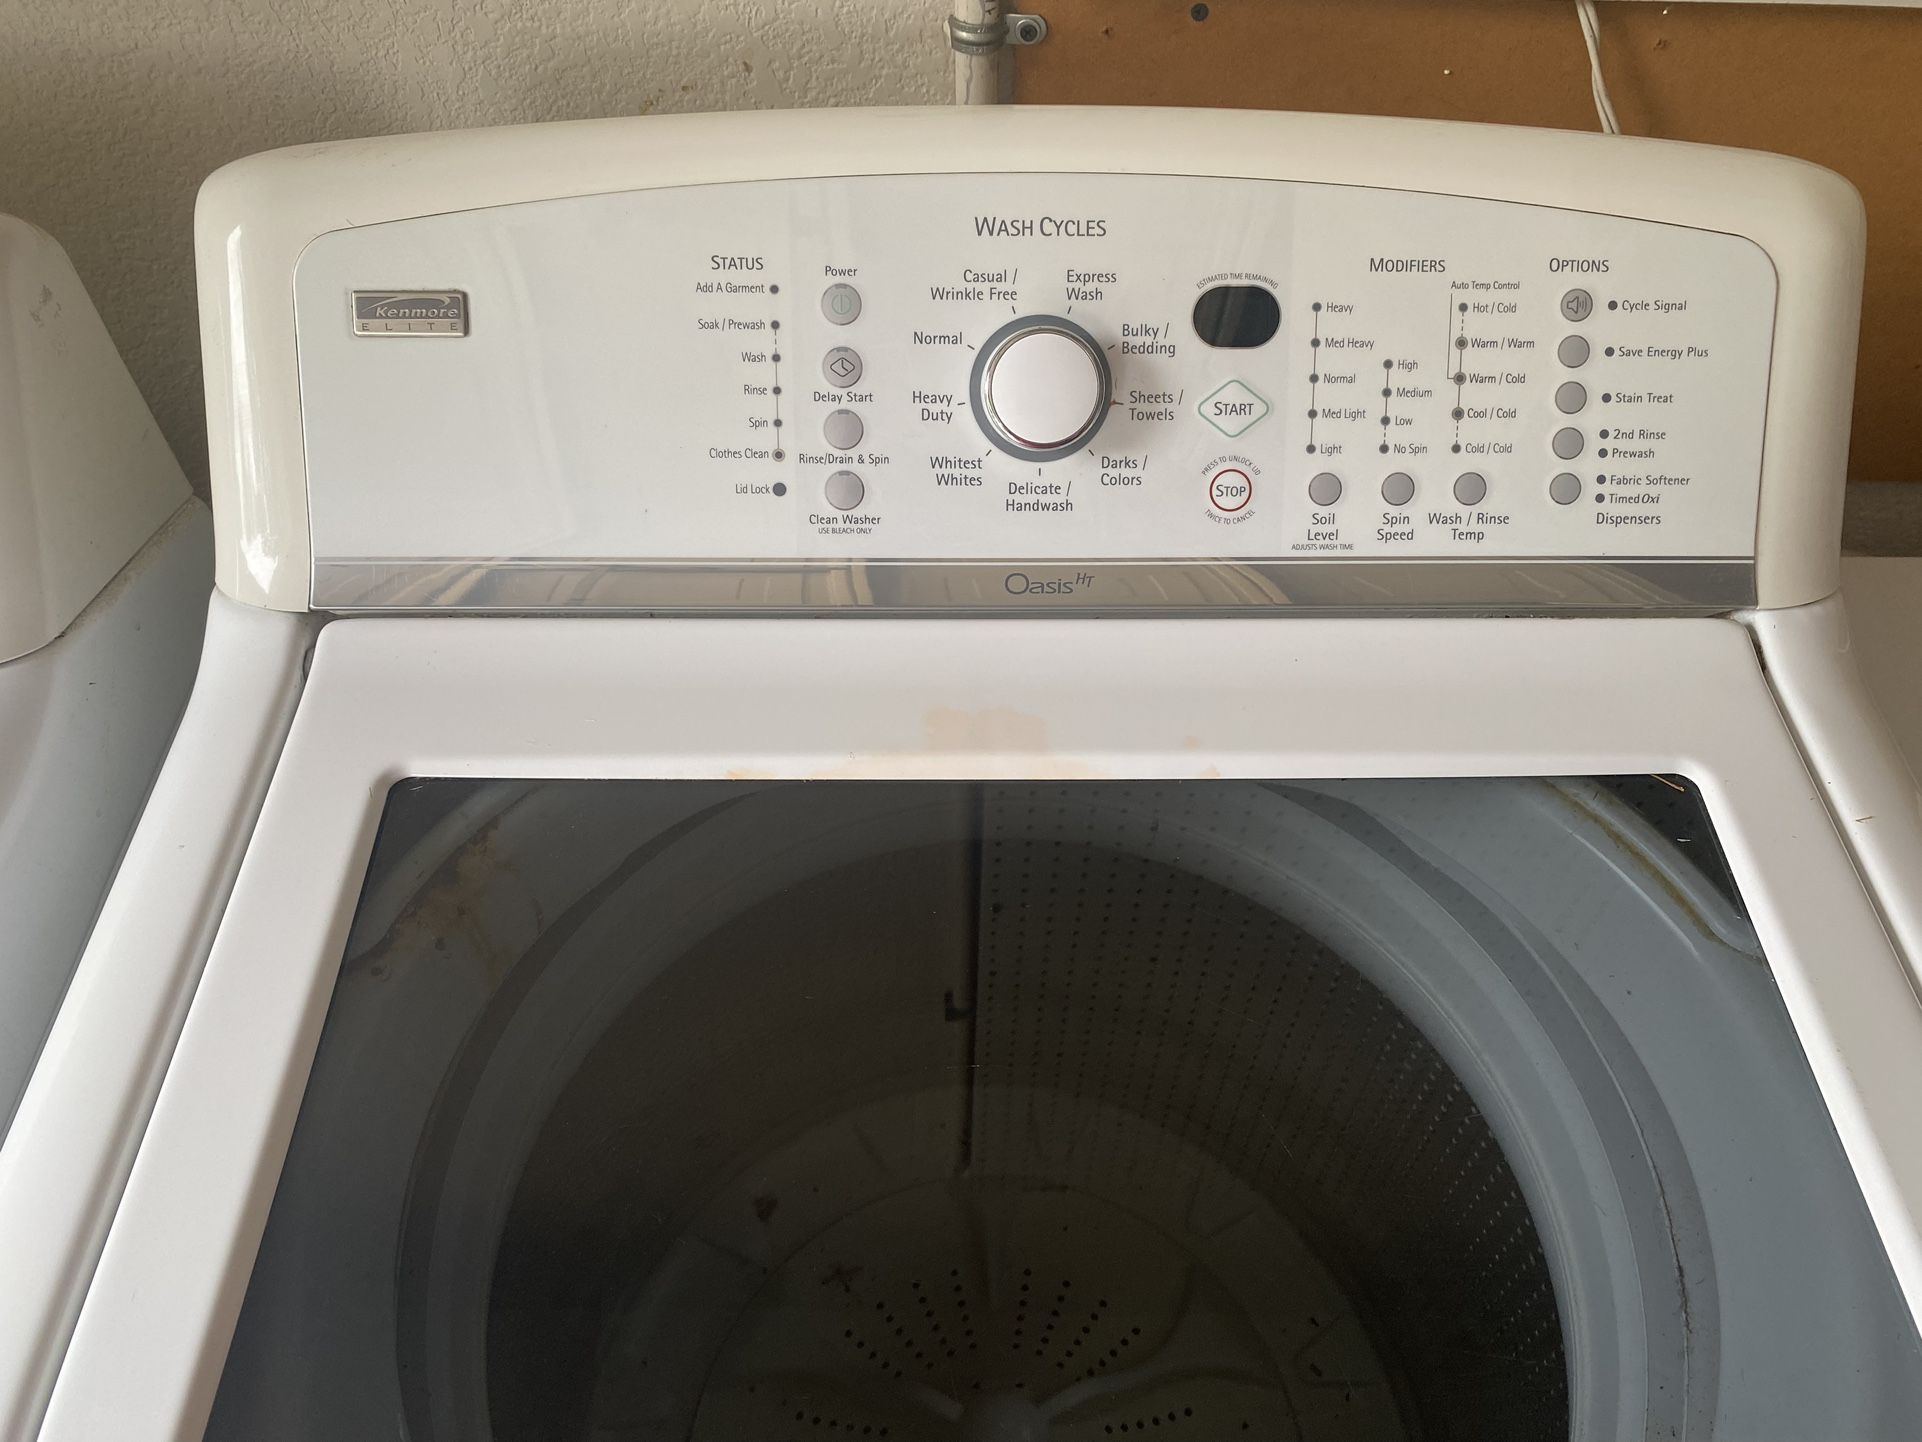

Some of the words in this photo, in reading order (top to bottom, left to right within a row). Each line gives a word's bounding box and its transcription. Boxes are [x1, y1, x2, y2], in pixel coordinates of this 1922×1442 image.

[974, 216, 1033, 236] WASH
[1039, 216, 1107, 237] CYCLES
[711, 255, 763, 270] STATUS
[1369, 258, 1446, 273] MODIFIERS
[1549, 257, 1609, 273] OPTIONS
[825, 266, 858, 277] Power
[963, 269, 1007, 283] Casual
[1066, 269, 1117, 286] Express
[695, 282, 714, 293] Add
[716, 282, 724, 293] A
[725, 282, 765, 294] Garment
[1196, 273, 1229, 290] ESTIMATED
[1244, 273, 1279, 290] REMAINING
[1450, 281, 1469, 290] Auto
[1471, 281, 1491, 291] Temp
[1493, 281, 1520, 290] Control
[930, 287, 984, 301] Wrinkle
[990, 287, 1018, 301] Free
[1066, 287, 1103, 301] Wash
[375, 306, 459, 318] Kenmore
[1326, 302, 1354, 315] Heavy
[1472, 303, 1489, 313] Hot
[1497, 302, 1517, 313] Cold
[1621, 300, 1650, 313] Cycle
[1654, 300, 1687, 313] Signal
[361, 322, 459, 331] ELITE
[697, 318, 720, 330] Soak
[728, 319, 766, 330] Prewash
[913, 331, 963, 345] Normal
[1122, 324, 1159, 339] Bulky
[1121, 342, 1176, 357] Bedding
[1325, 338, 1345, 349] Med
[1347, 338, 1375, 350] Heavy
[1470, 338, 1498, 349] Warm
[1507, 338, 1535, 349] Warm
[741, 352, 767, 363] Wash
[1618, 346, 1643, 357] Save
[1647, 346, 1684, 360] Energy
[1687, 346, 1709, 358] Plus
[1397, 359, 1418, 372] High
[1323, 373, 1356, 384] Normal
[1469, 373, 1496, 384] Warm
[1505, 373, 1526, 384] Cold
[744, 385, 768, 396] Rinse
[1129, 390, 1174, 404] Sheets
[1396, 387, 1432, 398] Medium
[813, 392, 843, 404] Delay
[846, 392, 873, 403] Start
[912, 391, 953, 407] Heavy
[1616, 392, 1643, 403] Stain
[1647, 393, 1674, 403] Treat
[1128, 408, 1174, 421] Towels
[1214, 401, 1254, 416] START
[1322, 409, 1341, 419] Med
[1344, 409, 1366, 421] Light
[1467, 408, 1487, 419] Cool
[1496, 408, 1517, 419] Cold
[921, 408, 953, 424] Duty
[1394, 415, 1413, 426] Low
[748, 417, 768, 430] Spin
[1613, 429, 1634, 440] 2nd
[1639, 429, 1666, 440] Rinse
[709, 448, 743, 459] Clothes
[744, 448, 769, 459] Clean
[1320, 444, 1342, 456] Light
[1393, 444, 1407, 454] No
[1409, 444, 1428, 456] Spin
[1465, 443, 1485, 454] Cold
[1493, 443, 1512, 454] Cold
[1612, 448, 1655, 459] Prewash
[799, 453, 853, 465] Rinse/Drain
[868, 453, 889, 467] Spin
[930, 456, 983, 469] Whitest
[1101, 456, 1138, 469] Darks
[1201, 458, 1219, 476] PRESS
[1219, 455, 1227, 464] TO
[1228, 455, 1253, 467] UNLOCK
[935, 473, 983, 486] Whites
[1100, 473, 1142, 486] Colors
[1610, 475, 1642, 486] Fabric
[1645, 475, 1690, 486] Softener
[735, 484, 748, 494] Lid
[750, 484, 770, 494] Lock
[1008, 482, 1061, 495] Delicate
[1215, 484, 1246, 497] STOP
[1005, 499, 1073, 512] Handwash
[809, 514, 838, 525] Clean
[842, 514, 881, 525] Washer
[1204, 509, 1222, 524] TWICE
[1223, 518, 1231, 526] TO
[1232, 510, 1256, 525] CANCEL
[1311, 513, 1335, 525] Soil
[1382, 513, 1410, 528] Spin
[1428, 513, 1462, 525] Wash
[1476, 513, 1510, 525] Rinse
[1596, 512, 1661, 527] Dispensers
[1307, 529, 1339, 541] Level
[1376, 528, 1414, 543] Speed
[1451, 528, 1485, 543] Temp
[1291, 543, 1318, 551] ADJUSTS
[1318, 543, 1339, 551] WASH
[1339, 543, 1354, 551] TIME
[1004, 572, 1074, 595] Oasis
